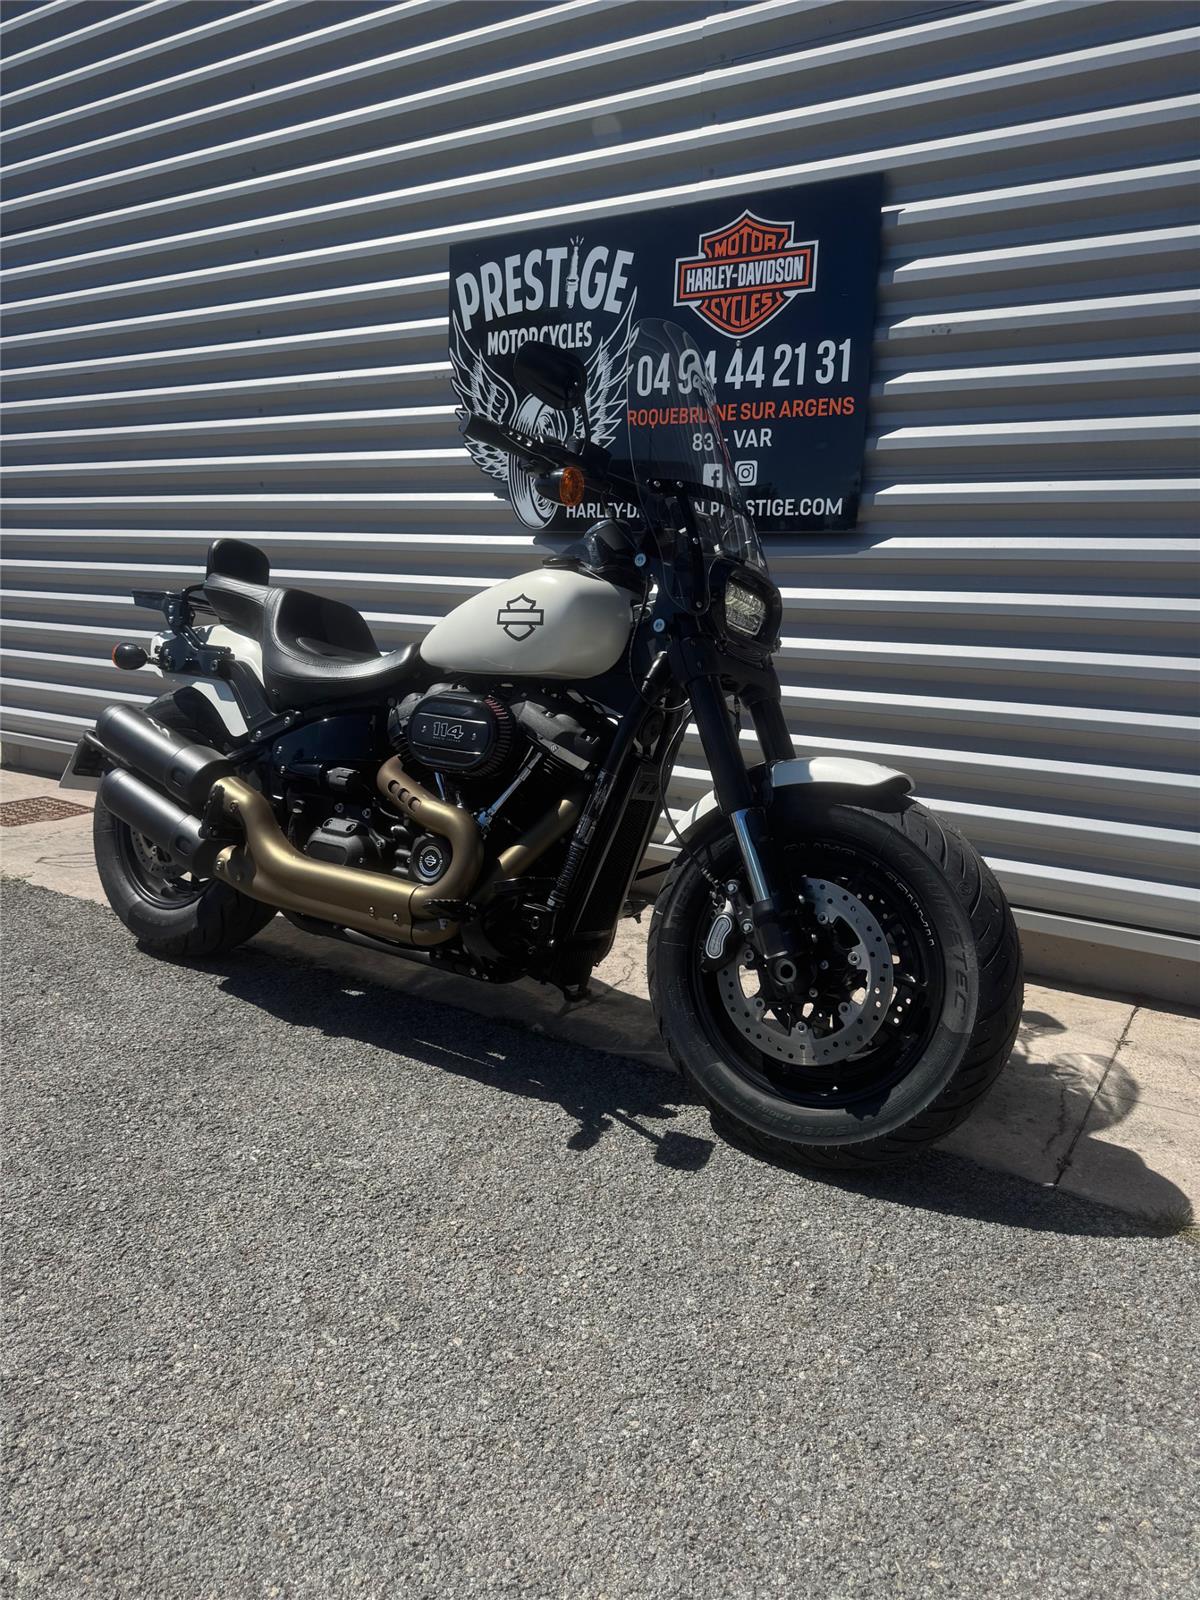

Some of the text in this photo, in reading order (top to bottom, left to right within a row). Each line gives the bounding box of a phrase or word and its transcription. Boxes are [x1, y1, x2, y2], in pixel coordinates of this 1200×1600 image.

[714, 226, 777, 257] MOTOR
[455, 245, 635, 331] PRESTIGE
[686, 256, 804, 292] HARLEY-DAVIDSON
[711, 291, 773, 327] CYCLES
[636, 353, 670, 396] 04
[725, 346, 765, 389] 44
[772, 342, 806, 387] 21
[815, 338, 851, 384] 31
[740, 400, 776, 420] SUR
[779, 396, 855, 418] ARGENS
[692, 433, 714, 451] 83
[733, 428, 773, 448] VAR
[432, 721, 465, 740] 114
